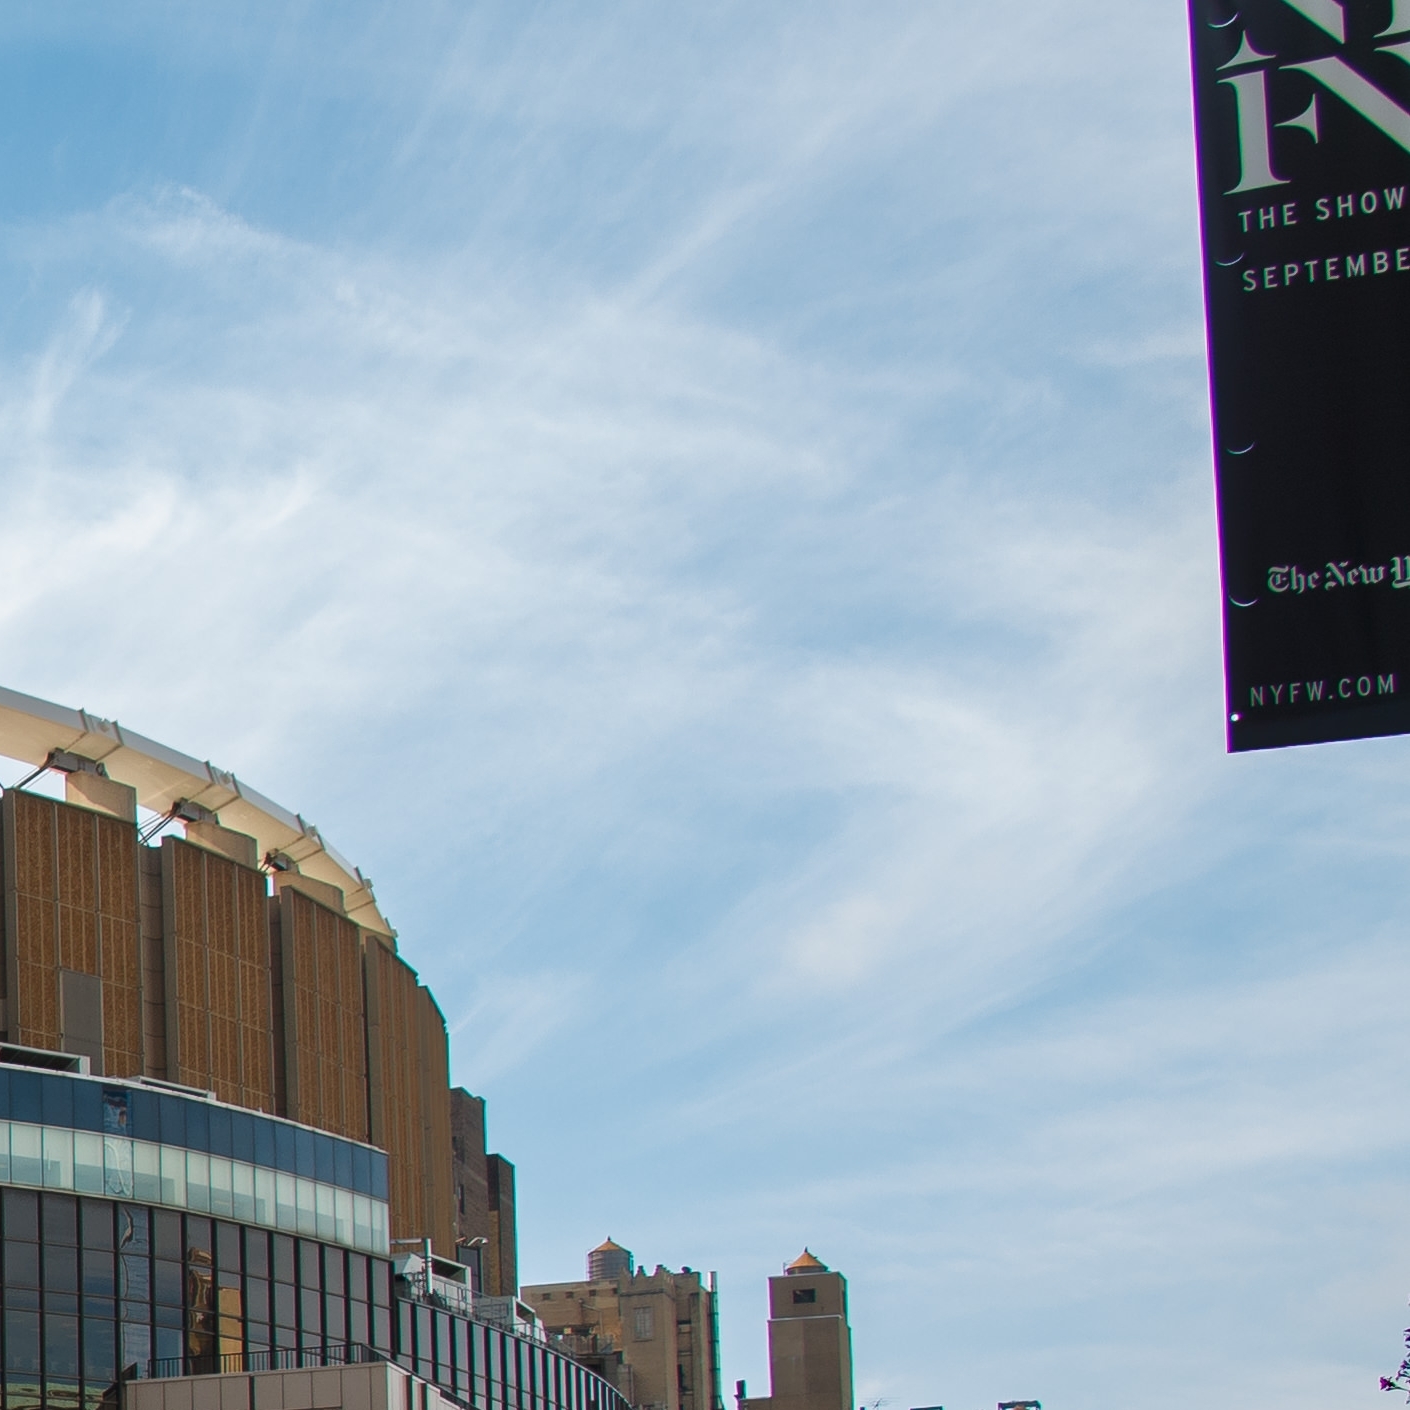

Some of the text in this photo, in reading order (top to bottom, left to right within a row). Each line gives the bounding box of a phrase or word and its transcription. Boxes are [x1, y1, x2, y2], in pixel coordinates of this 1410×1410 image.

[1237, 202, 1298, 233] THE
[1267, 564, 1320, 594] The
[1325, 560, 1386, 591] New
[1249, 673, 1395, 707] NYFW.COM
